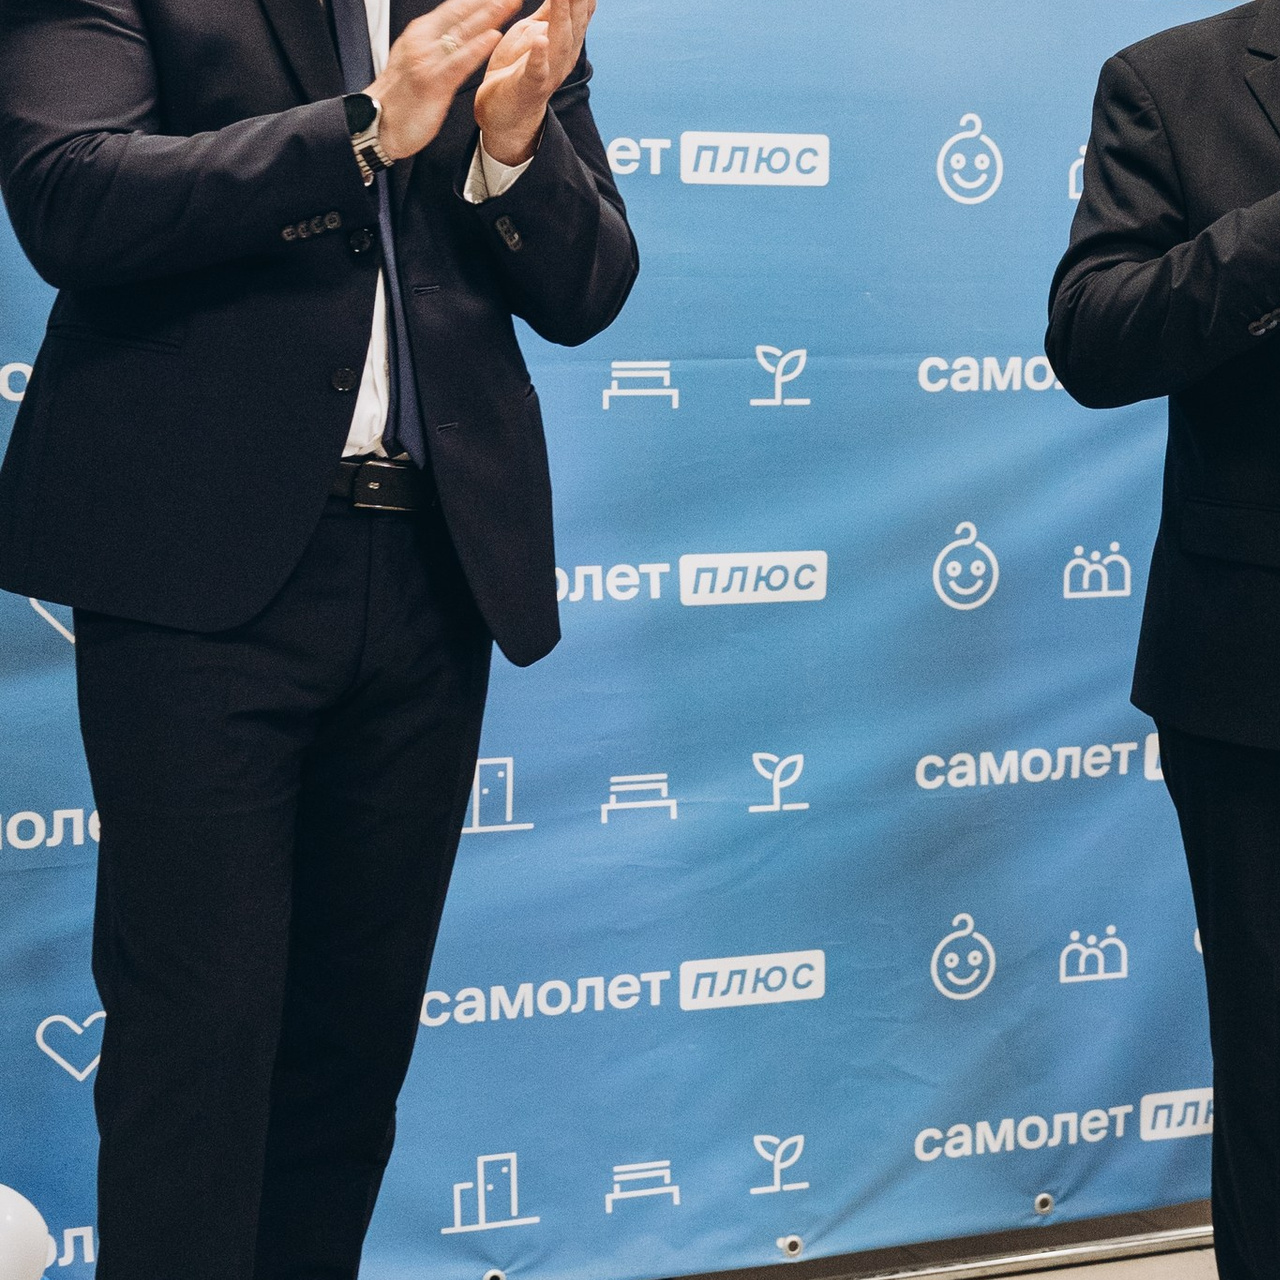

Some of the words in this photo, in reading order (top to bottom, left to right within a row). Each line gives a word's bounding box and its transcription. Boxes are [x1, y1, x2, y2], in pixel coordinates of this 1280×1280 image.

[917, 355, 1064, 393] само
[914, 741, 1139, 791] самолет
[419, 969, 672, 1028] самолет
[913, 1103, 1134, 1163] самолет
